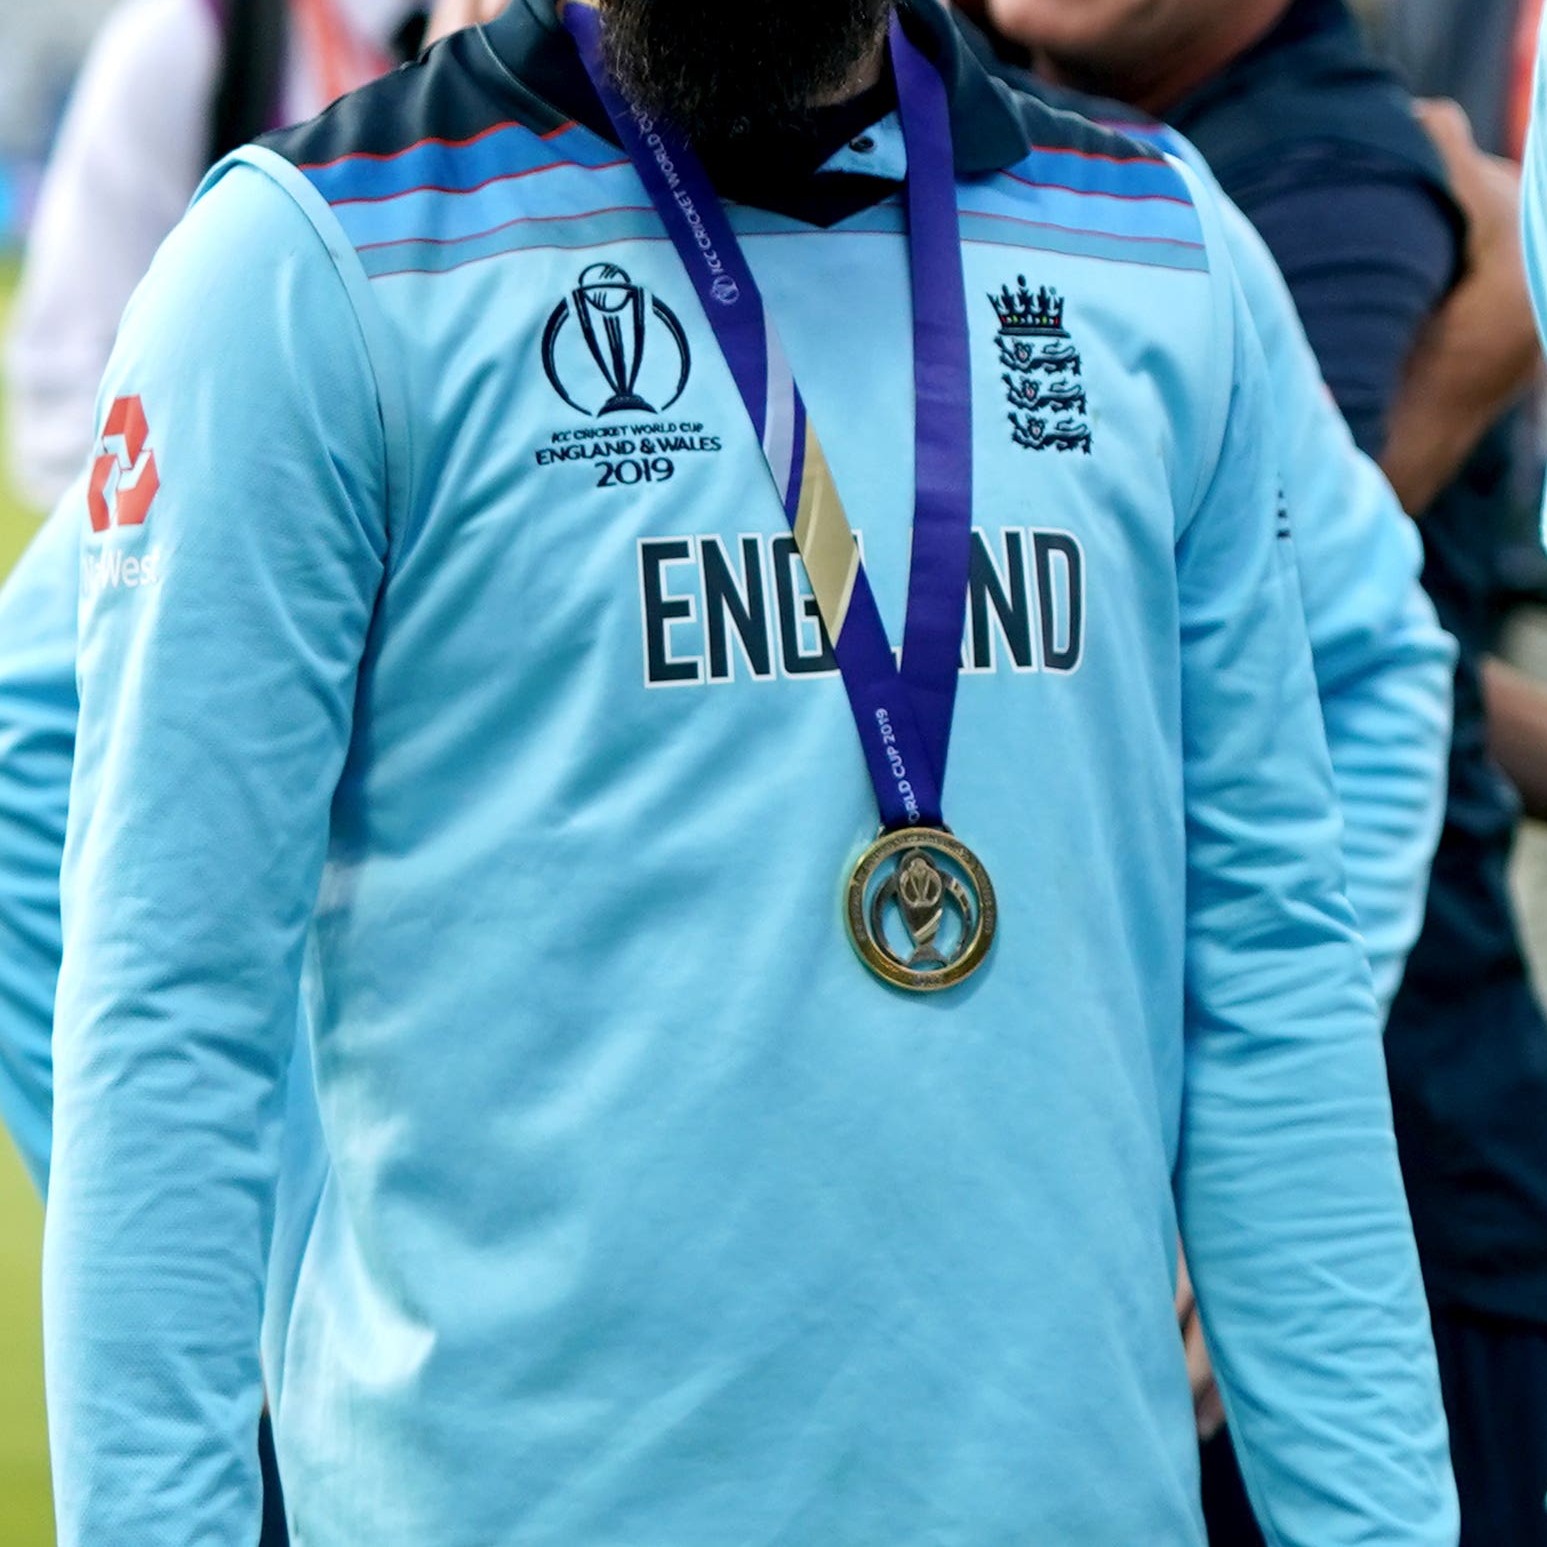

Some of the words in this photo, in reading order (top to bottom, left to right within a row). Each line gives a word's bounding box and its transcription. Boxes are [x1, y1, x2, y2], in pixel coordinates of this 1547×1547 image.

[647, 133, 680, 190] WORLD
[673, 191, 712, 250] CRICKET
[573, 425, 628, 441] CRICKET
[630, 422, 677, 436] WORLD
[679, 422, 704, 433] CUP
[535, 440, 636, 466] ENGLAND
[640, 440, 657, 454] &
[655, 436, 722, 452] WALES
[594, 457, 675, 488] 2019
[875, 707, 897, 744] 2019
[886, 744, 907, 779] CUP
[897, 779, 921, 824] ORLD
